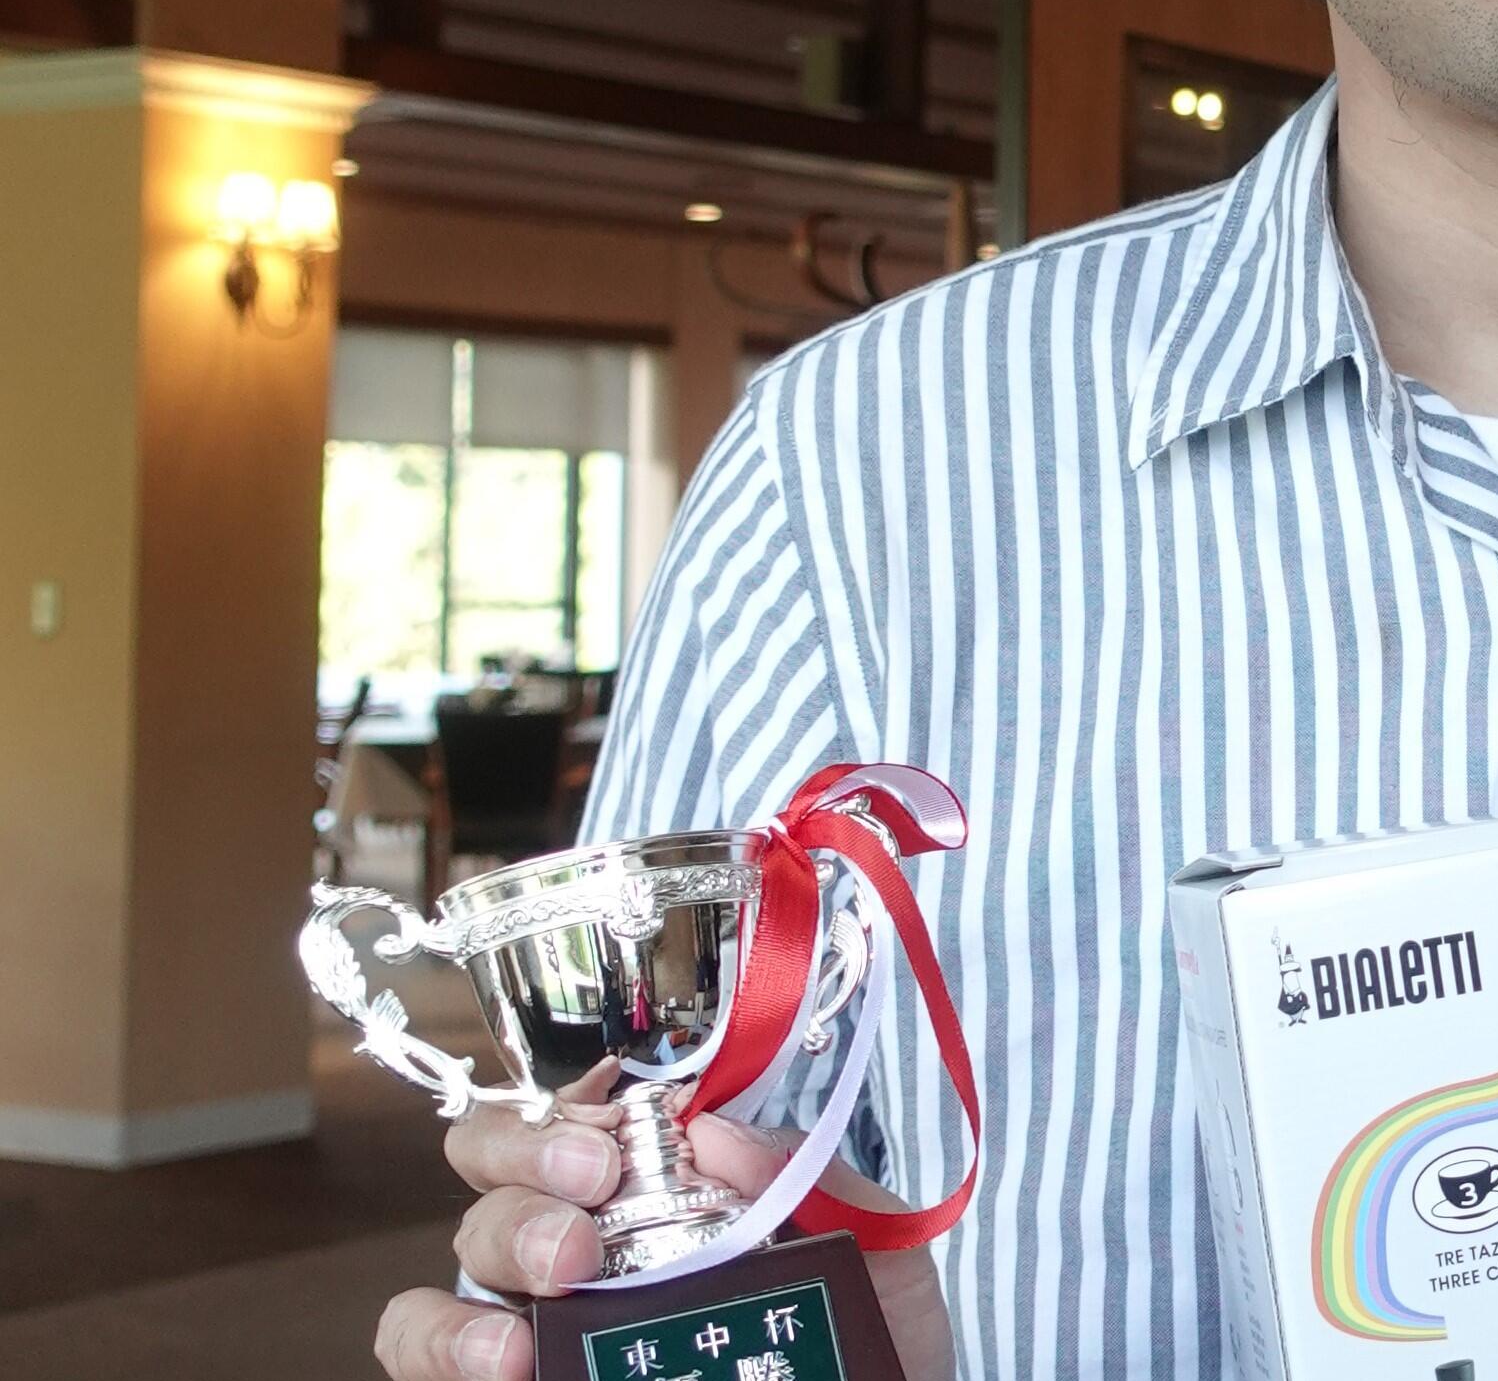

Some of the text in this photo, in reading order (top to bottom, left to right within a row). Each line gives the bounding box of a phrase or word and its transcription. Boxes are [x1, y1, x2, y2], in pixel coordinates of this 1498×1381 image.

[1458, 1182, 1479, 1207] 3
[1435, 1248, 1465, 1268] TRE
[1429, 1268, 1481, 1293] THREE
